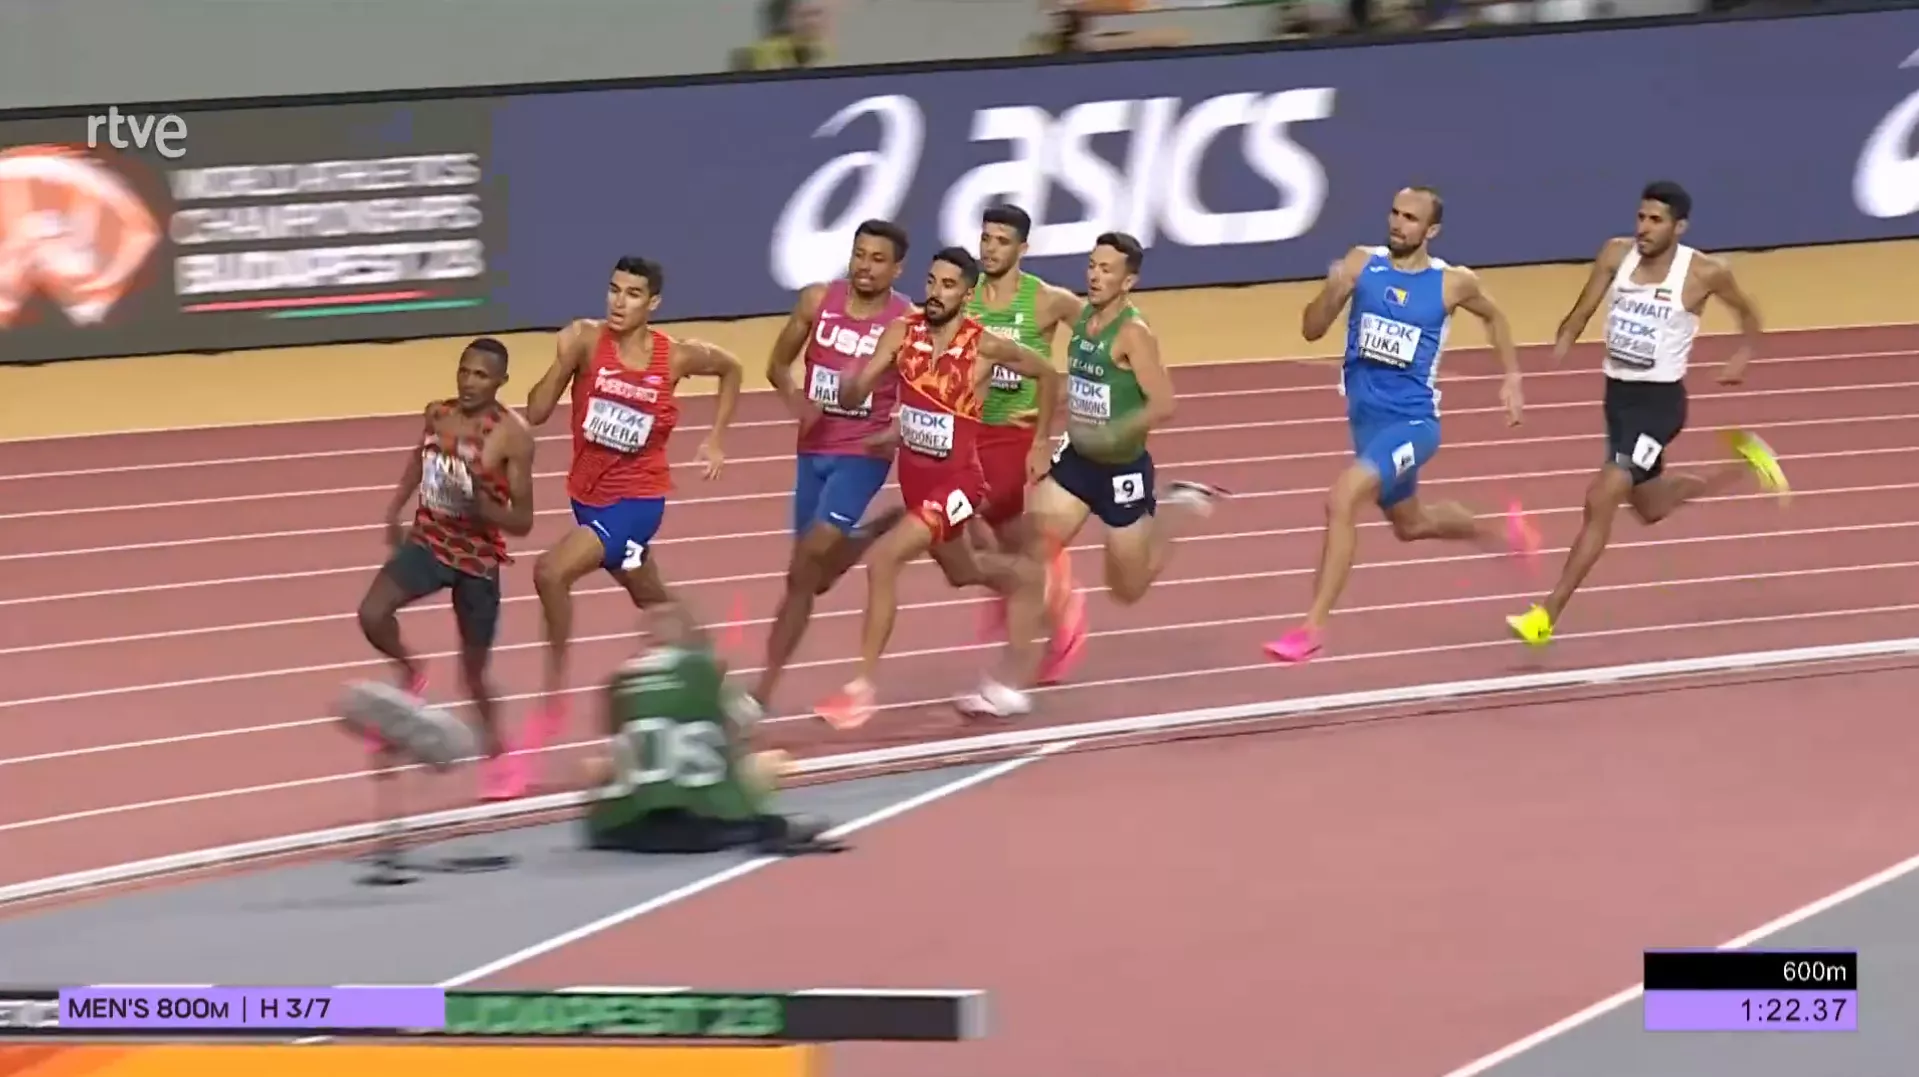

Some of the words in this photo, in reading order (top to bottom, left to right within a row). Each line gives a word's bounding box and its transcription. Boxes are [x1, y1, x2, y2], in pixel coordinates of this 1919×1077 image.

[1374, 318, 1415, 342] TDK
[1364, 332, 1401, 355] TUKA
[1074, 380, 1104, 398] TDK
[588, 416, 640, 444] RIVERA
[909, 410, 948, 429] TDK
[1122, 479, 1135, 498] 9
